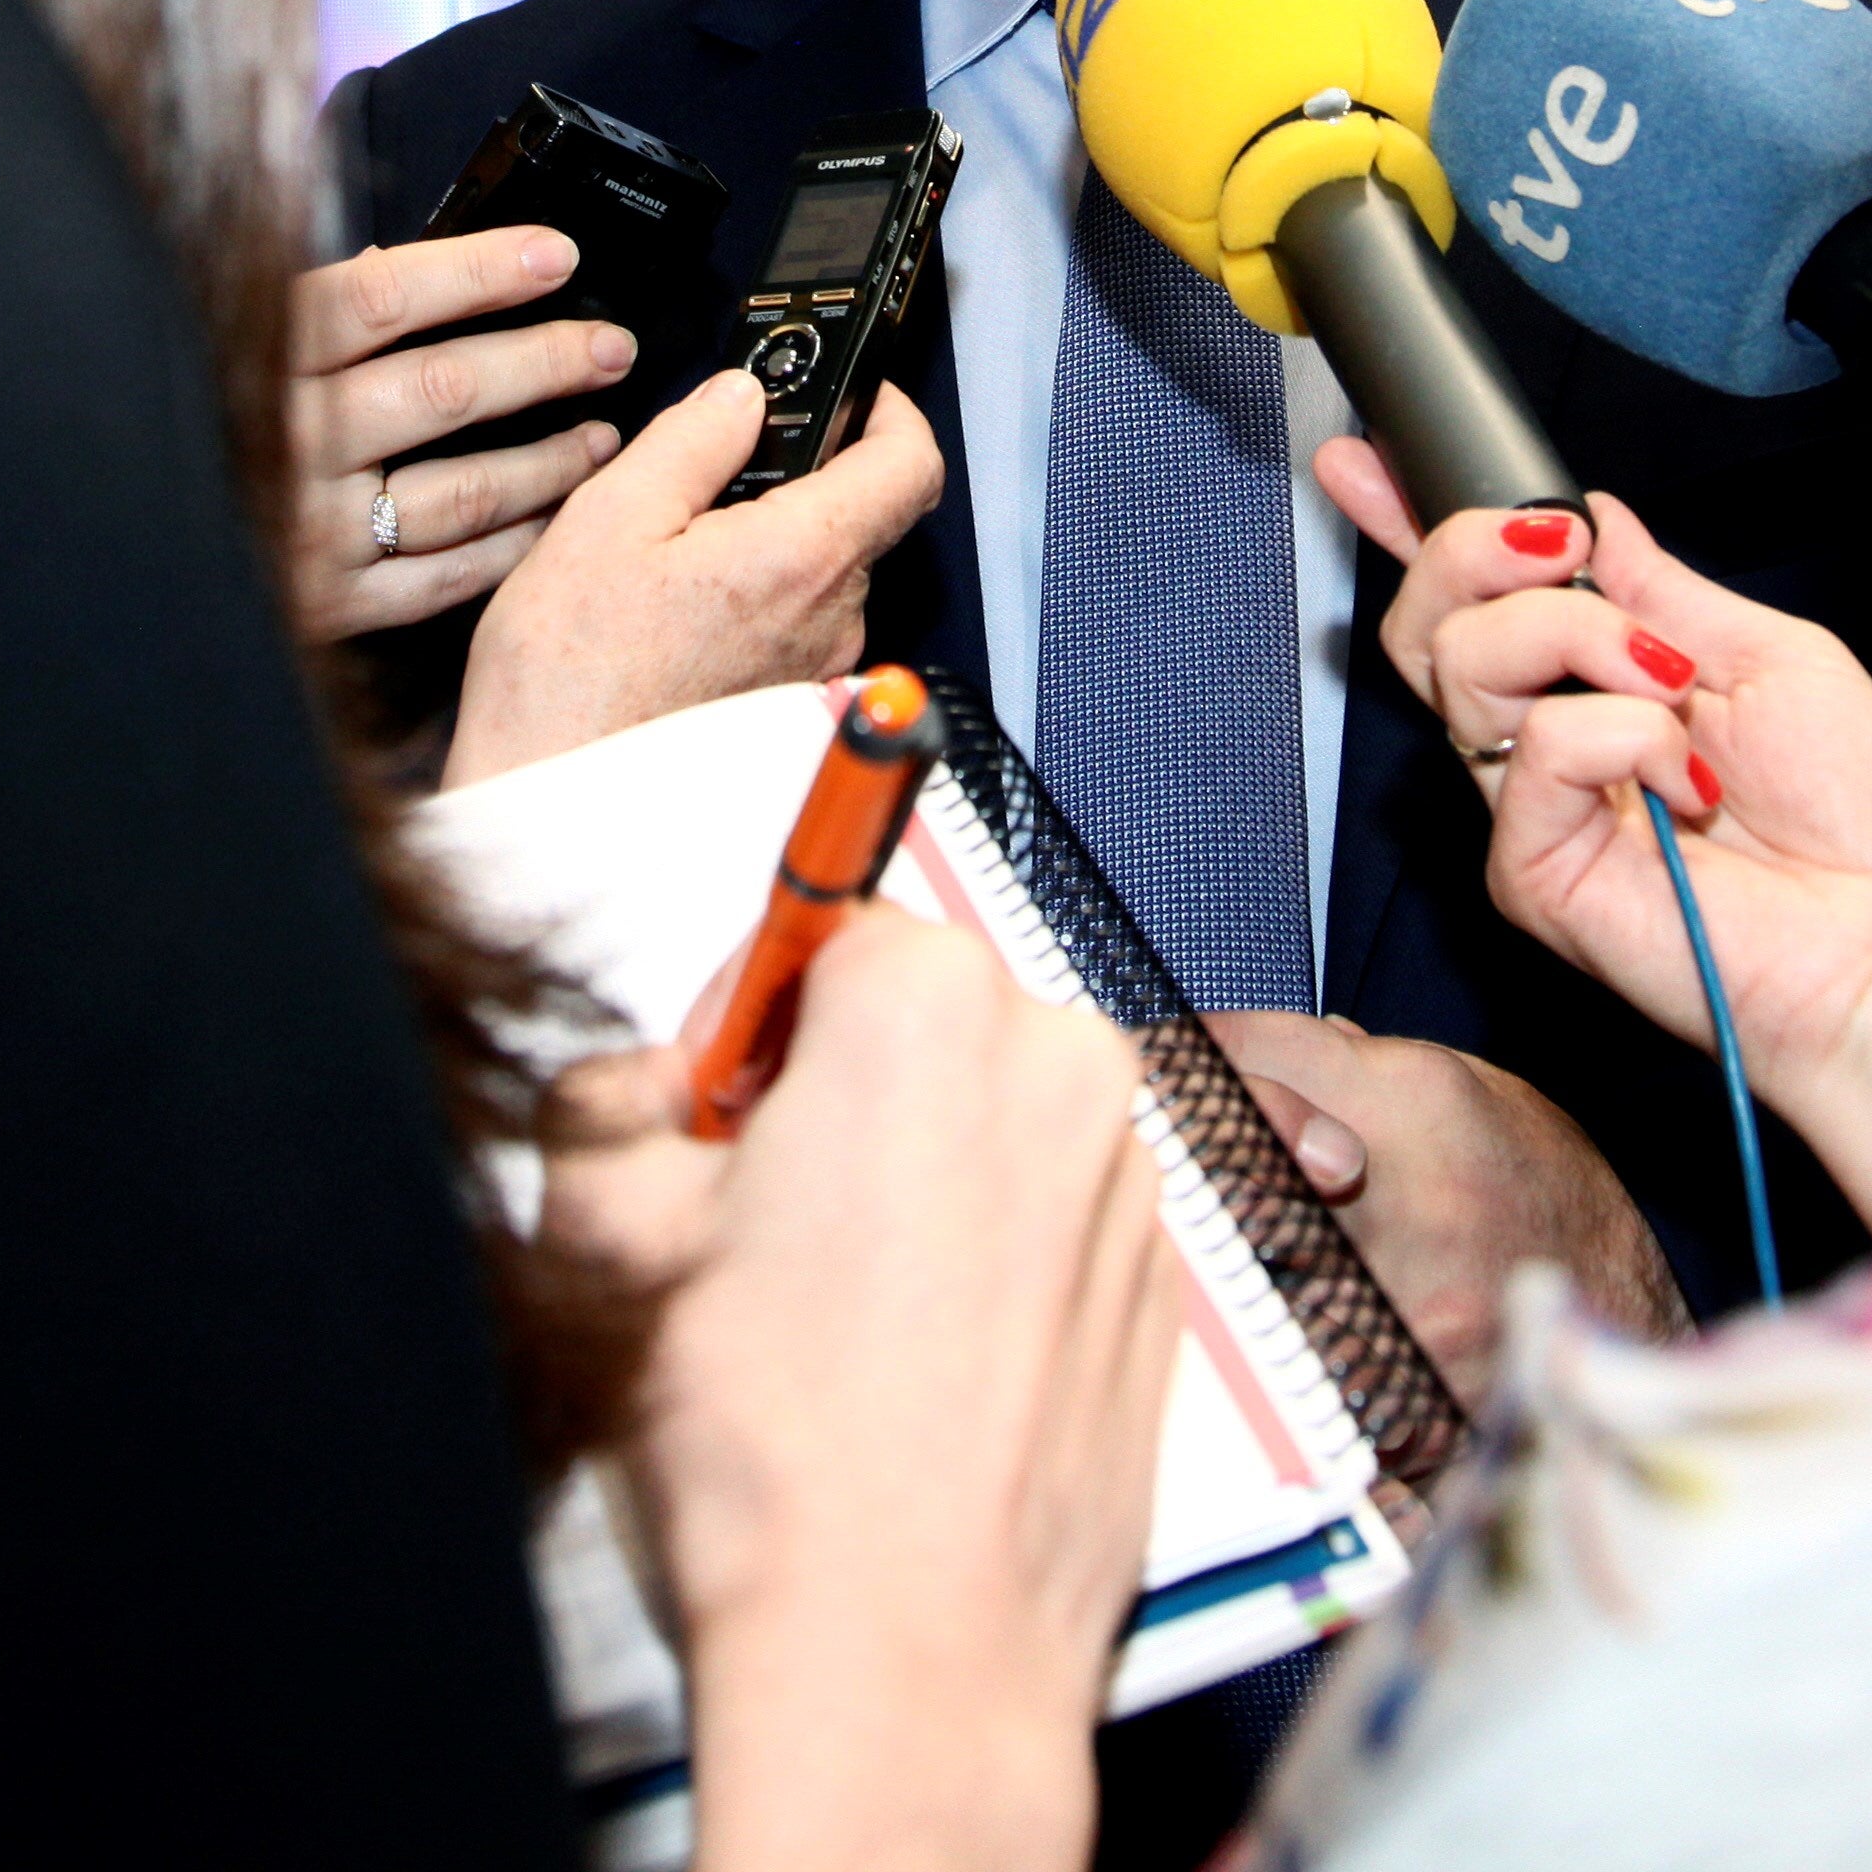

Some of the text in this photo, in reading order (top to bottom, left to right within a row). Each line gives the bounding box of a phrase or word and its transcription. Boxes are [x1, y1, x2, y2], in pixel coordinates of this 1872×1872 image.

[817, 155, 887, 171] OLYMPUS
[1488, 64, 1640, 264] tve
[604, 178, 669, 214] marantz
[887, 219, 900, 244] STOP
[746, 313, 785, 323] PODCAST
[740, 470, 786, 481] RECORDER
